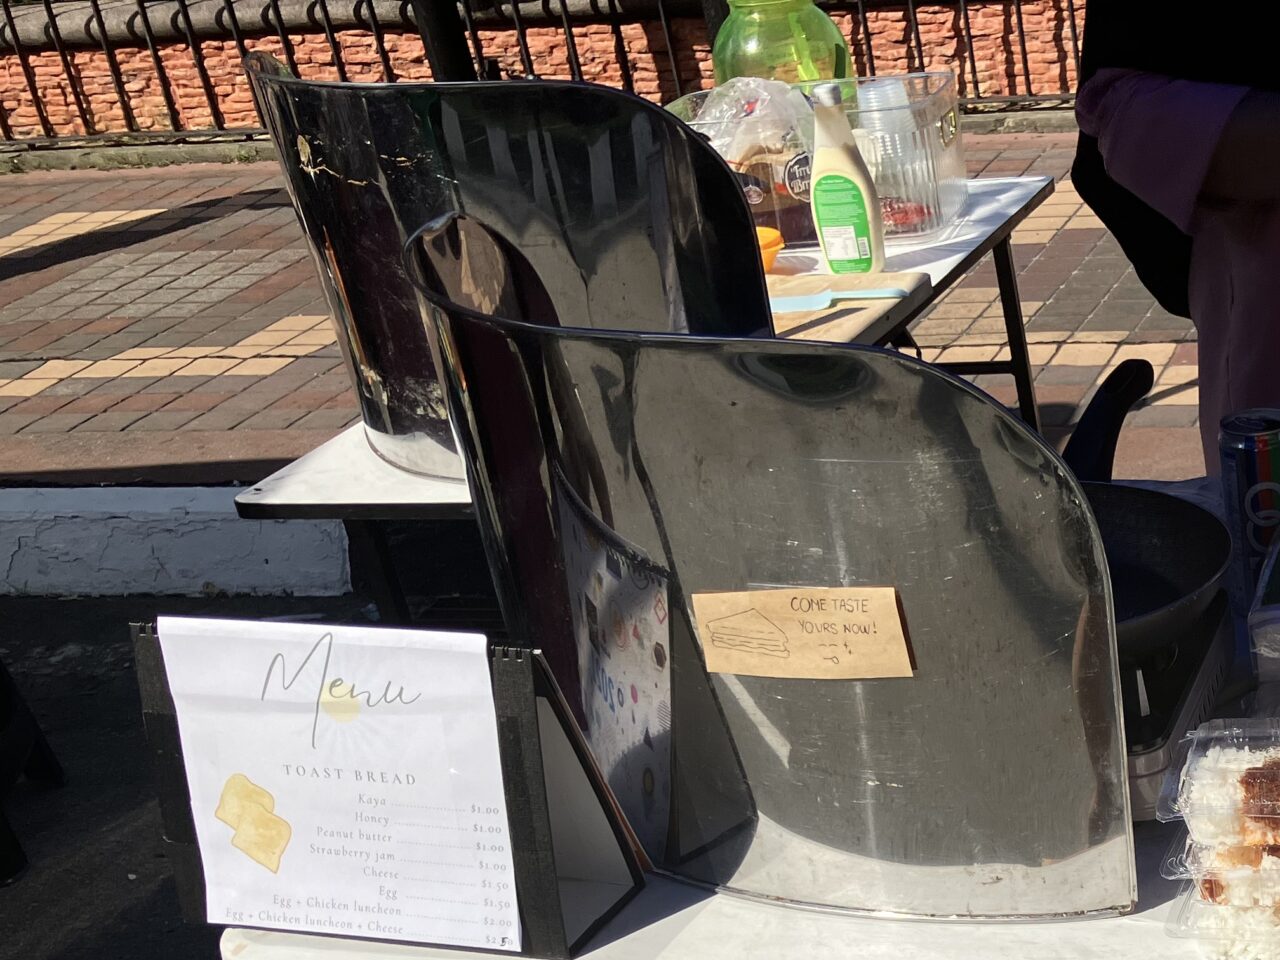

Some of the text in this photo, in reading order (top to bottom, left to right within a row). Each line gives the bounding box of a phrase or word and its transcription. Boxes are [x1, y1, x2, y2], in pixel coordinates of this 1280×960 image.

[790, 597, 869, 613] COME TASTE
[798, 620, 878, 635] YOURS NOW!
[261, 632, 421, 749] Menu
[283, 764, 416, 785] TOAST BREAD
[358, 793, 500, 815] Kaya $1.00
[355, 811, 502, 833] Honey $1.00
[316, 826, 504, 852] Peanut butter $1.00
[310, 843, 507, 871] Strawberry jam $1.00
[363, 866, 509, 892] Cheese $1.50
[273, 894, 292, 908] Egg
[306, 896, 349, 911] Chicken
[354, 901, 402, 916] luncheon
[483, 917, 512, 927] $2.00
[379, 885, 511, 911] Egg $1.50
[225, 907, 244, 922] Egg
[258, 910, 301, 924] Chicken
[305, 914, 353, 929] luncheon
[367, 921, 403, 934] Cheese
